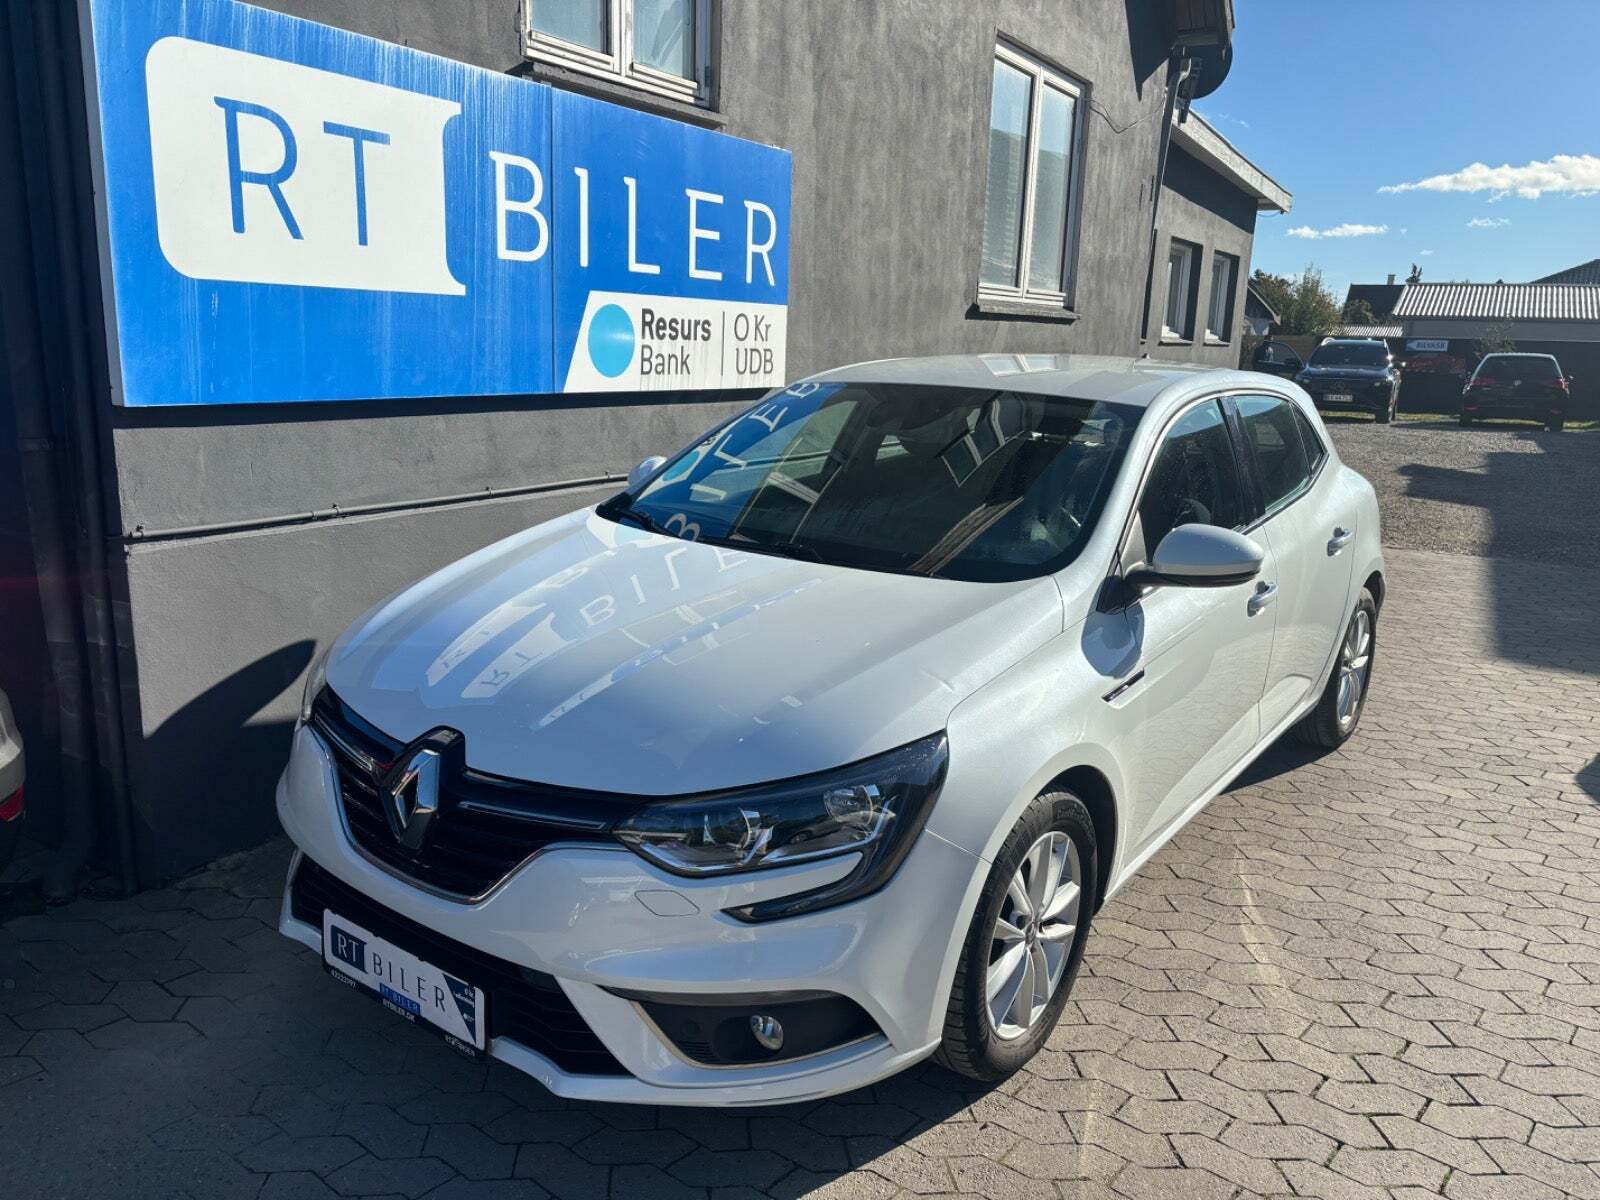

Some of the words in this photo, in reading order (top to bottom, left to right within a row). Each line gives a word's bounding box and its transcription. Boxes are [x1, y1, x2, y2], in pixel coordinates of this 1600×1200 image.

[213, 95, 391, 247] RT
[488, 149, 777, 287] BILER
[640, 308, 711, 342] Resurs
[753, 314, 771, 342] Kr
[639, 345, 691, 376] Bank
[735, 347, 774, 375] UDB
[336, 932, 359, 963] RT
[372, 951, 446, 1013] BILER
